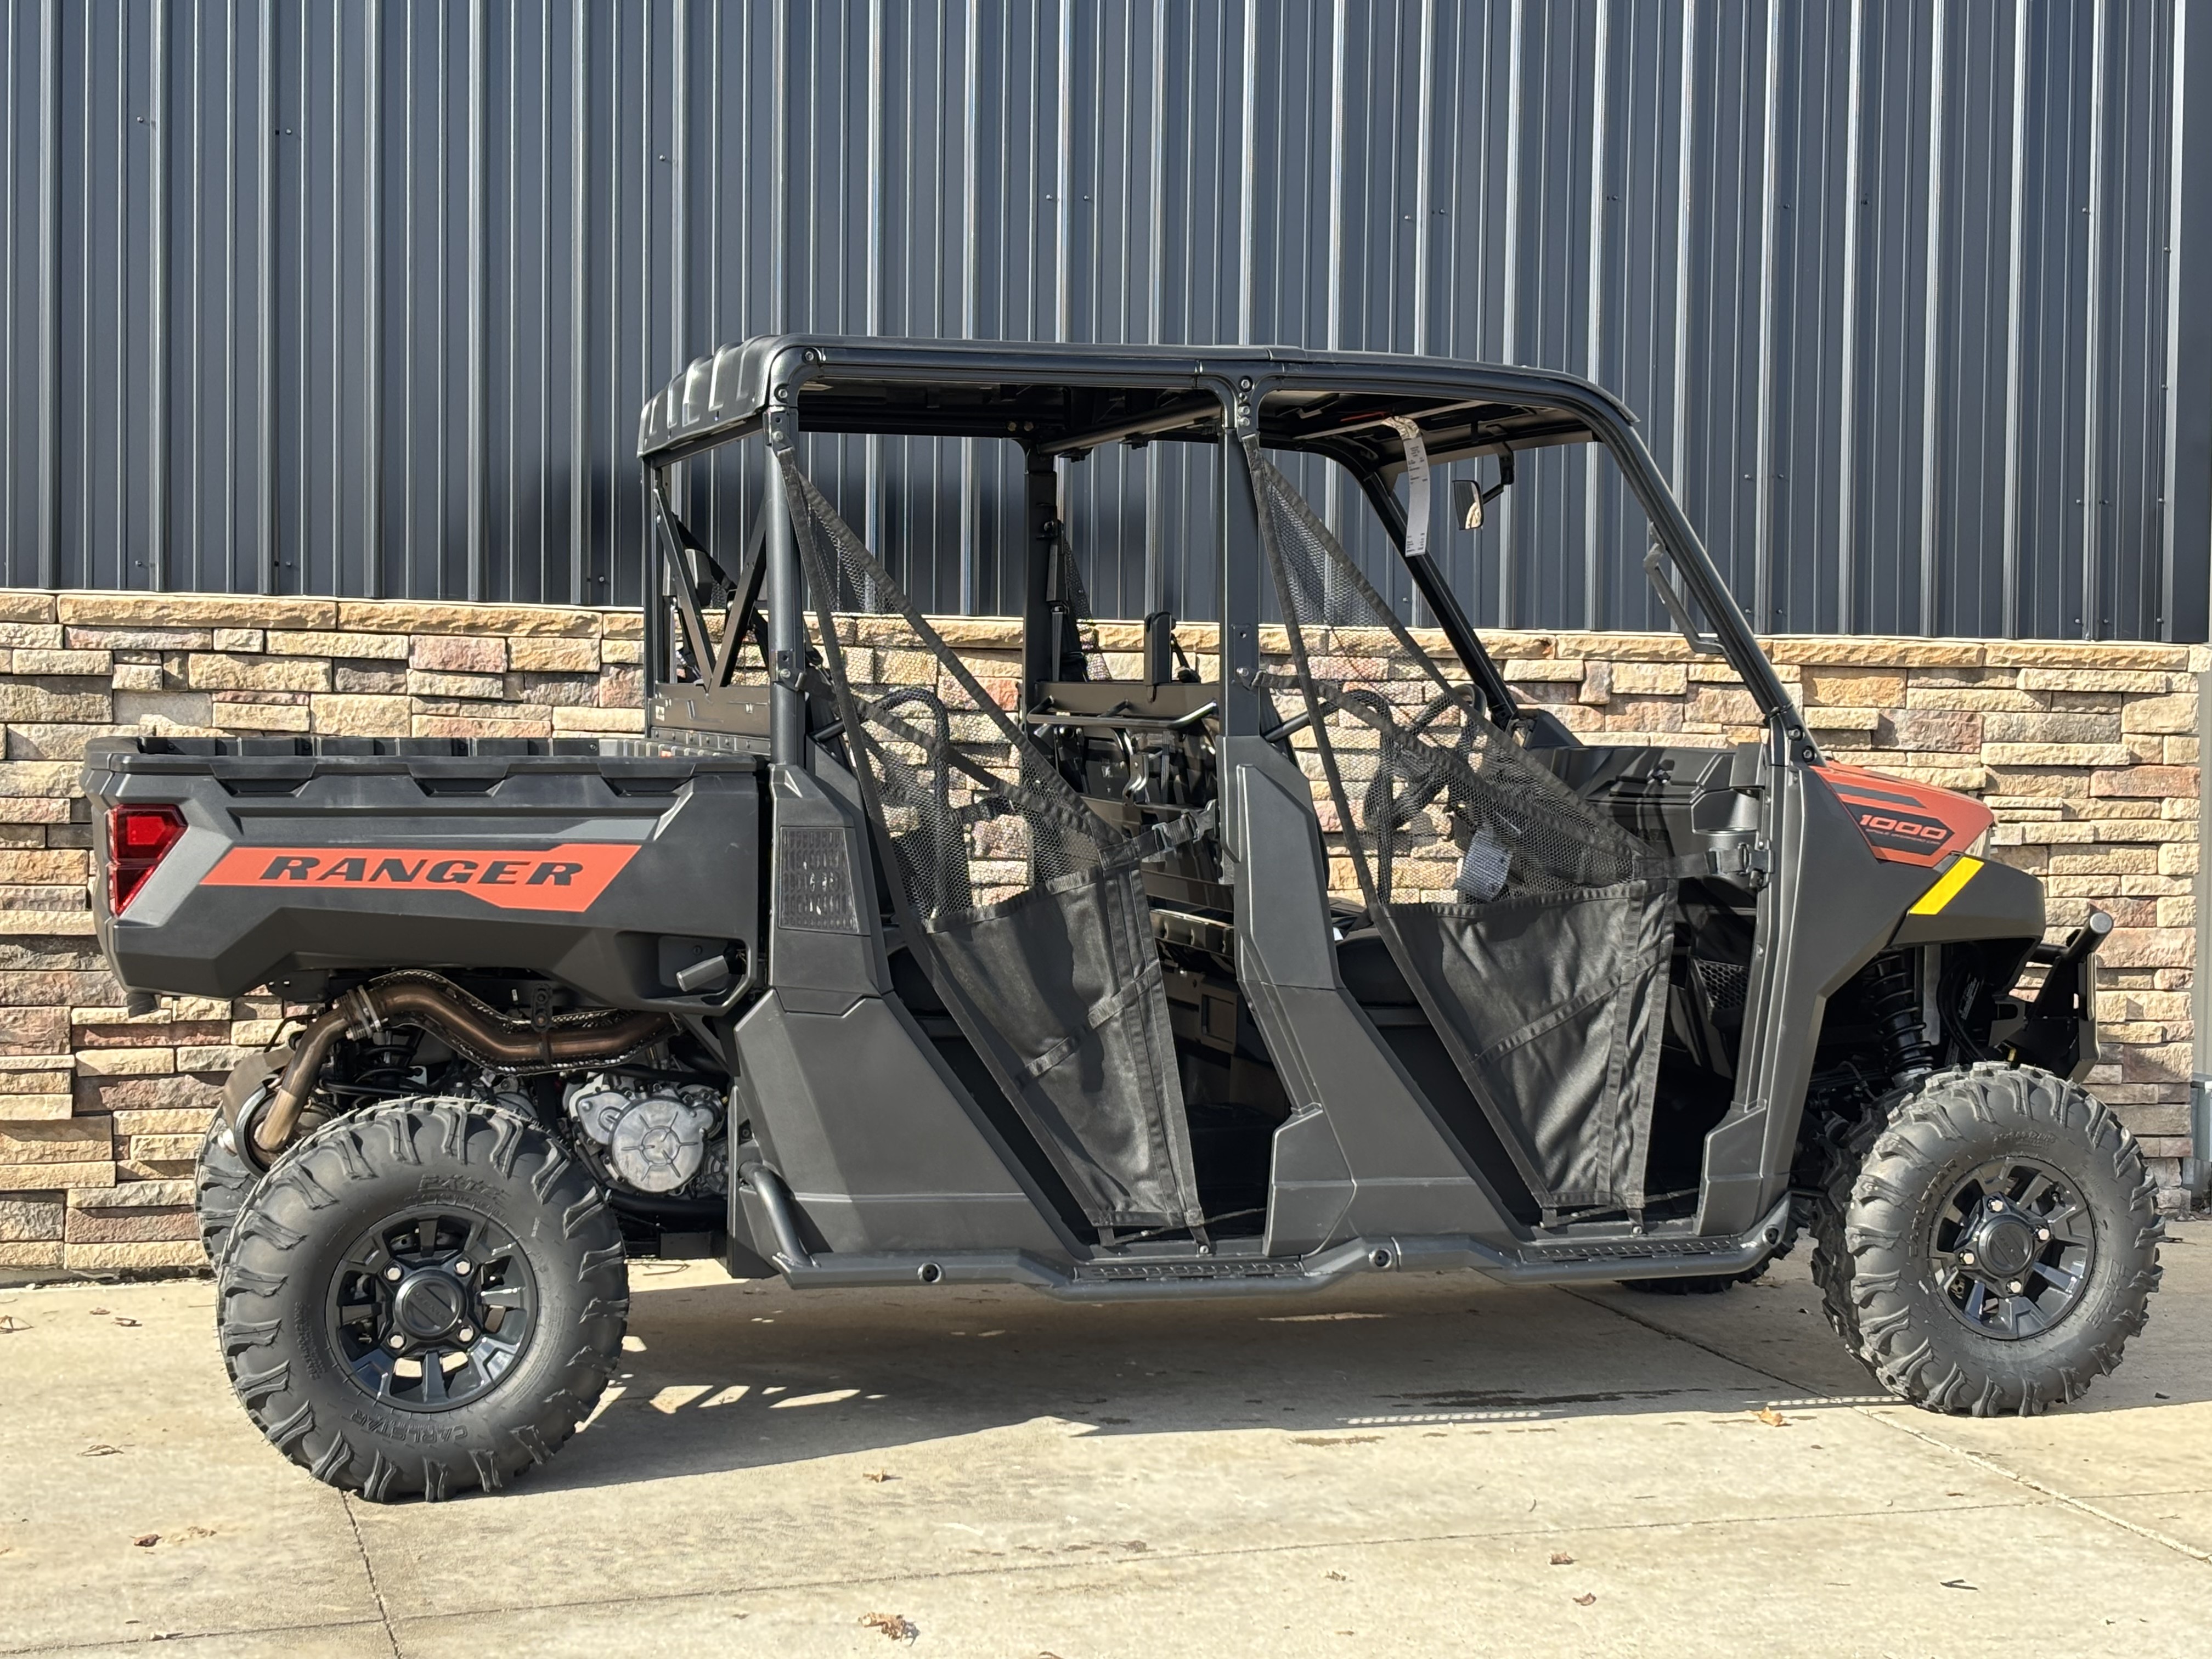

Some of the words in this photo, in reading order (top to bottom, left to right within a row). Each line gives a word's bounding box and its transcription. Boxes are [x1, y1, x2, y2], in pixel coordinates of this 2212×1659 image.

[1860, 814, 1947, 840] 1000
[259, 856, 583, 886] RANGER
[351, 1409, 467, 1443] CARLSTAR
